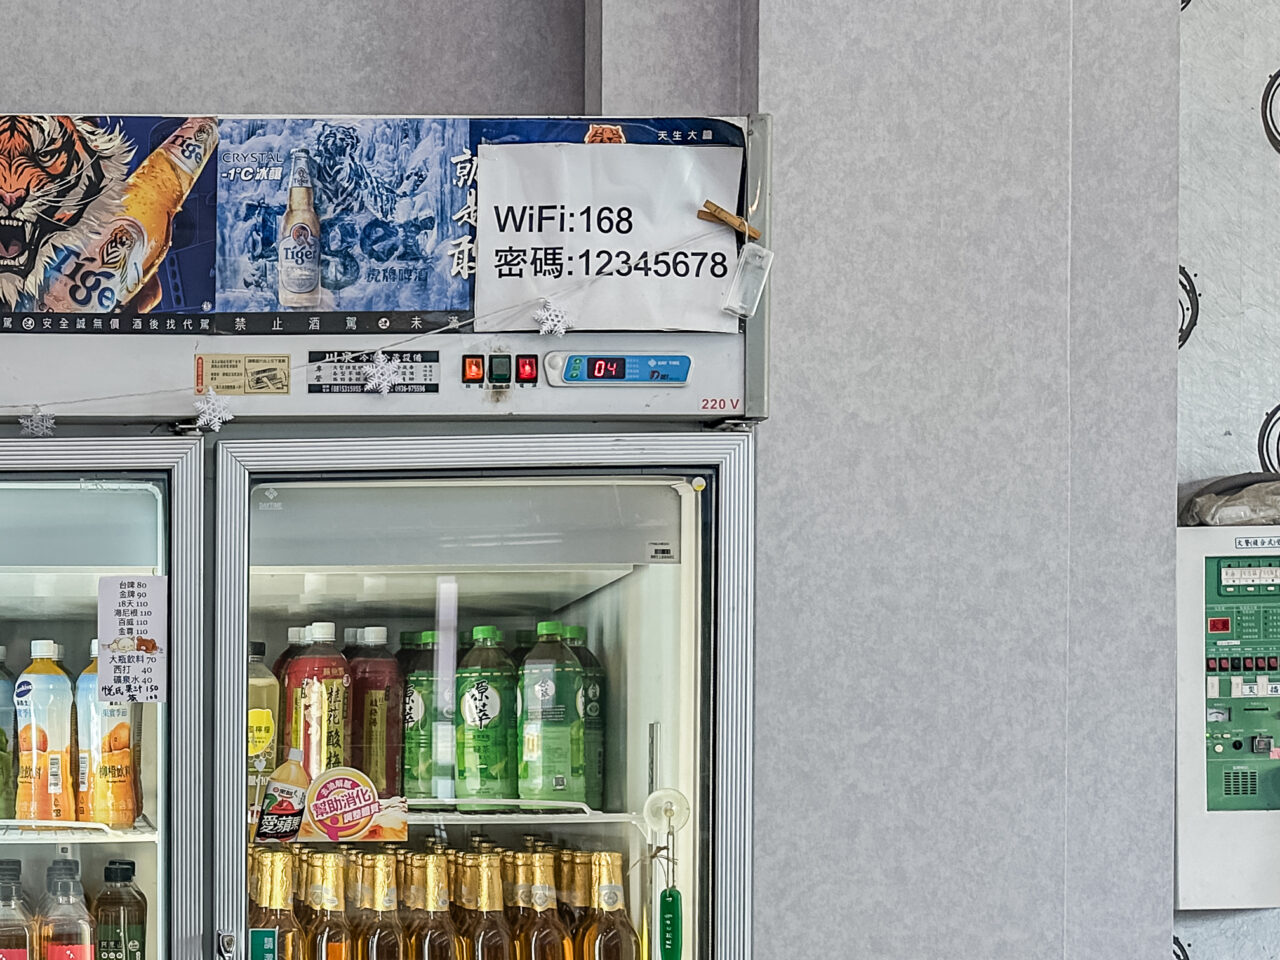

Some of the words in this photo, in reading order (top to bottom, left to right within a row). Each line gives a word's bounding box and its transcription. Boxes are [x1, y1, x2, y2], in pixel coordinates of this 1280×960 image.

[222, 152, 284, 163] CRYSTAL
[493, 204, 634, 237] WiFi:168
[283, 246, 317, 266] Tiger
[493, 244, 729, 281] 密碼:12345678
[42, 316, 120, 331] 安全誠無價
[131, 317, 211, 332] 酒後找代駕
[593, 359, 617, 377] 04
[701, 398, 726, 410] 220
[728, 398, 740, 410] V
[119, 590, 136, 599] 金牌
[114, 609, 138, 617] 海尼根
[108, 655, 145, 664] 大瓶飲料
[113, 665, 131, 674] 西打
